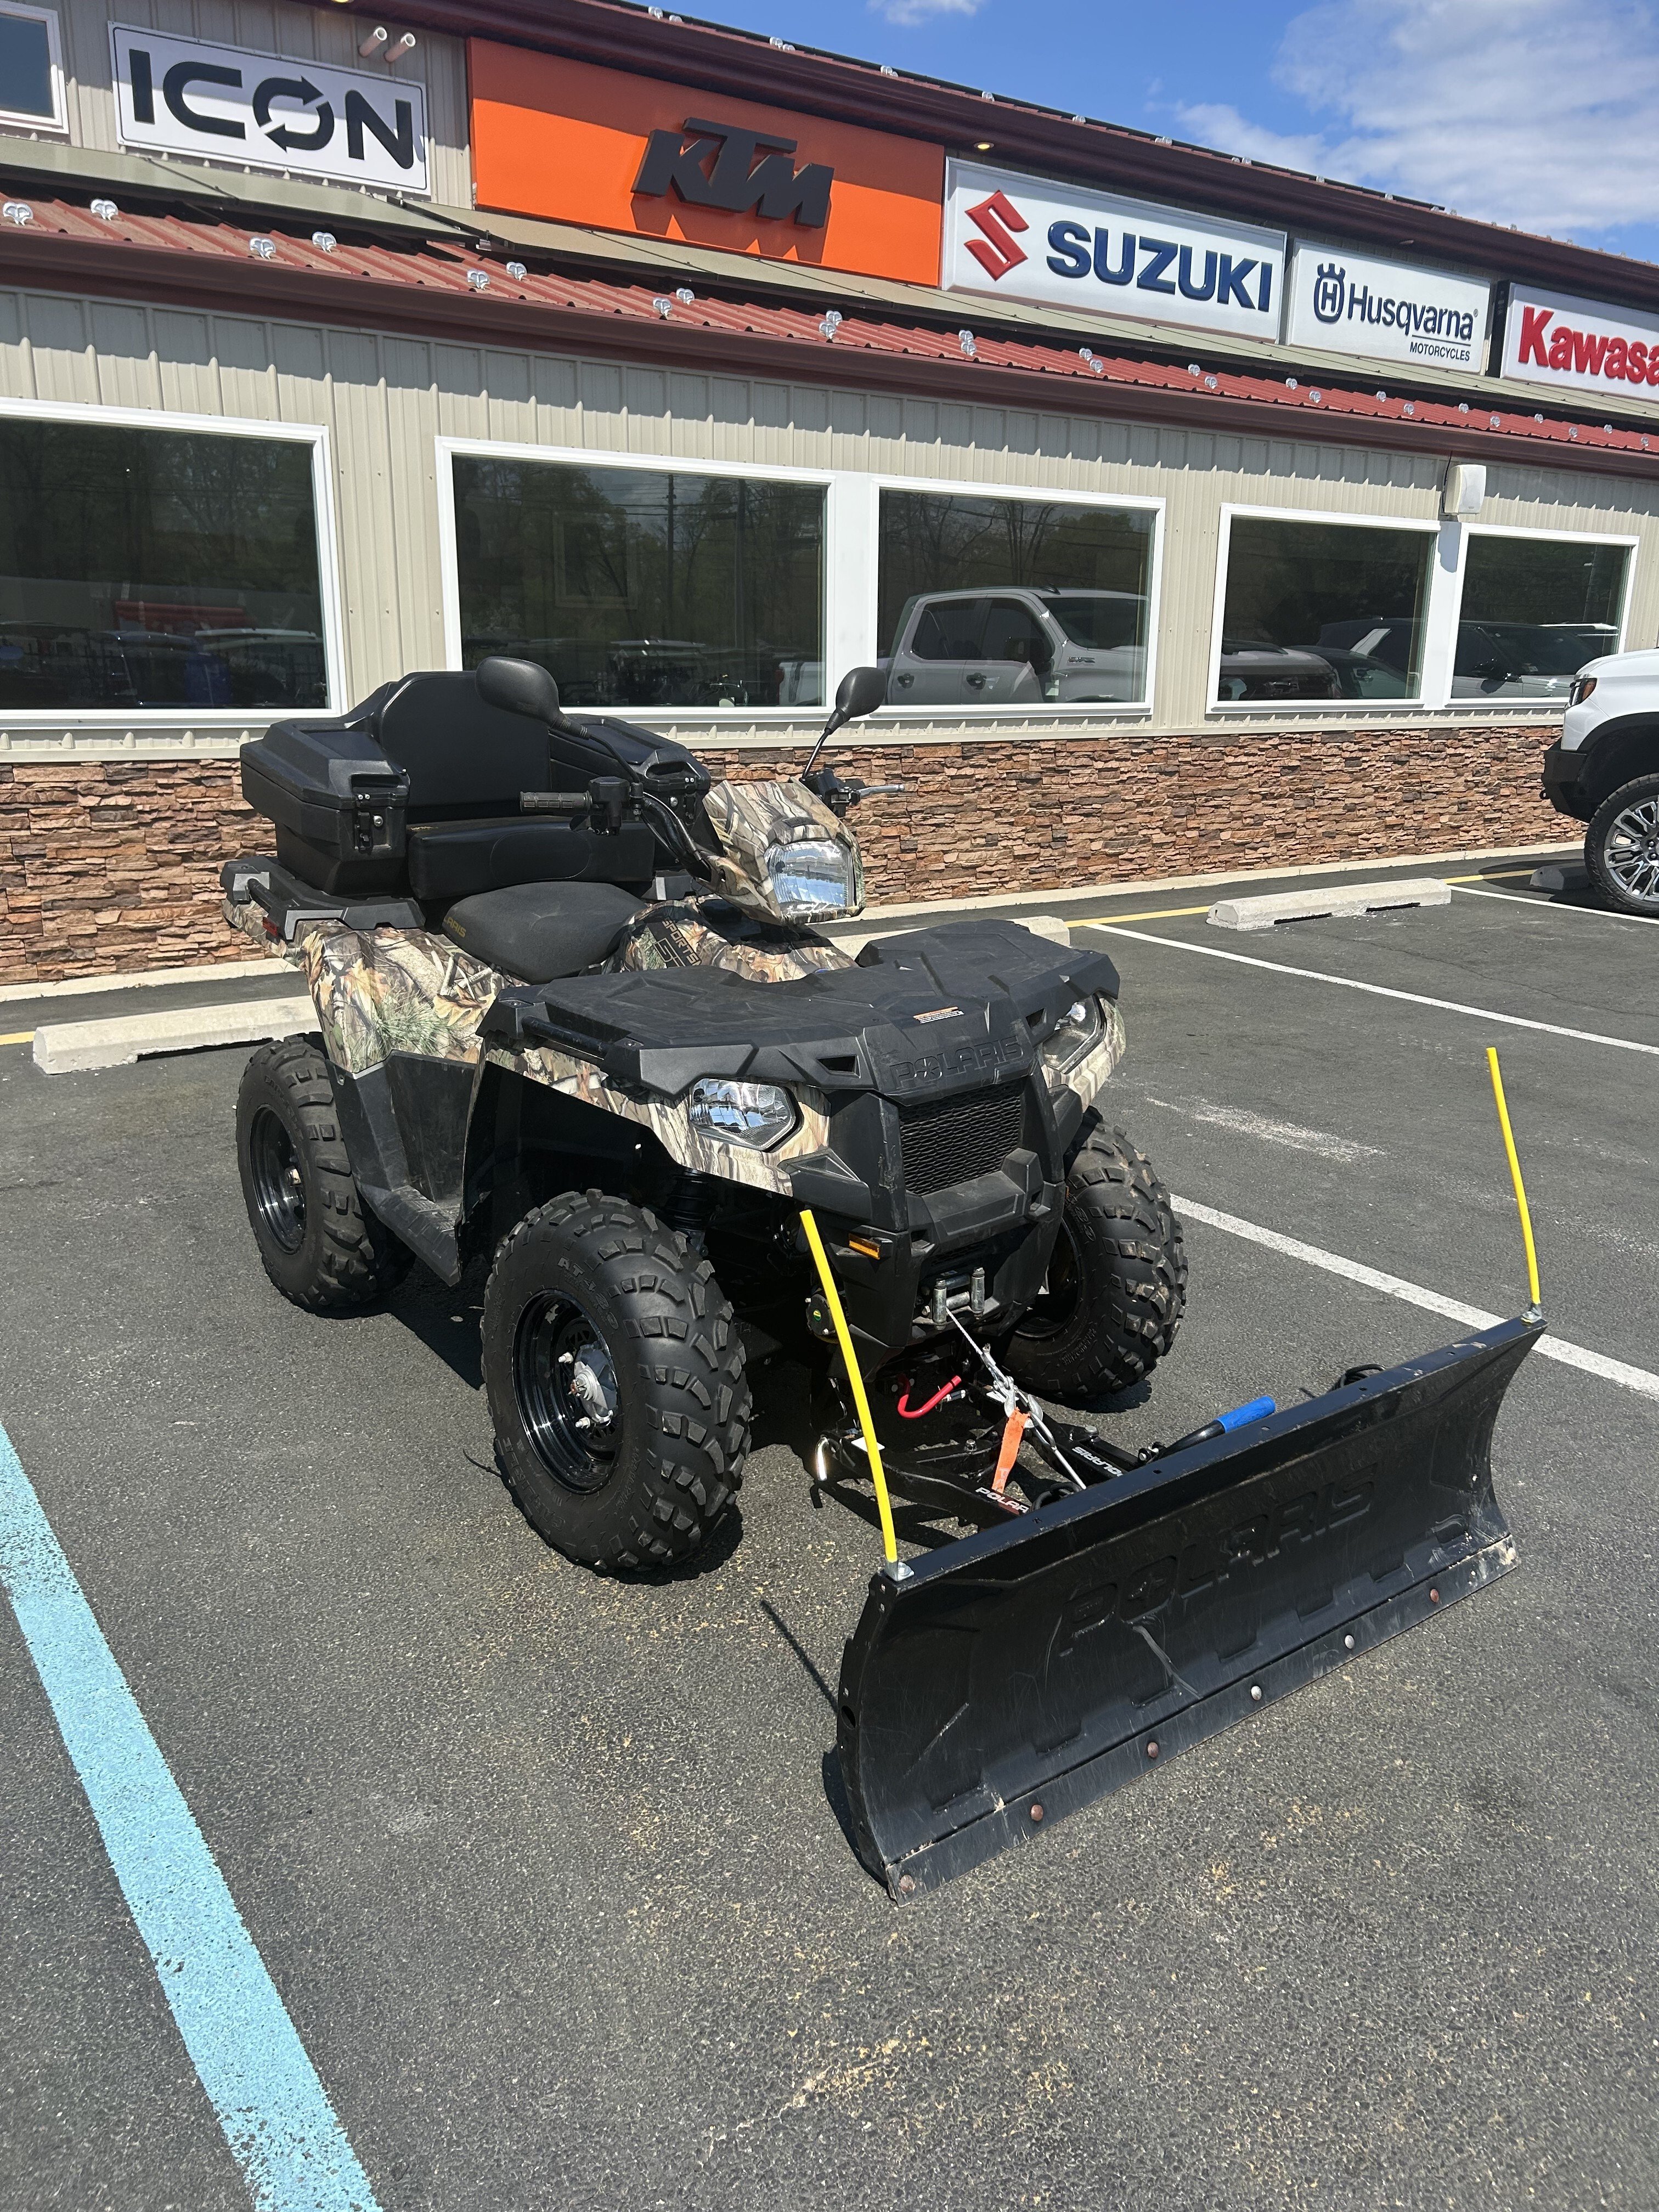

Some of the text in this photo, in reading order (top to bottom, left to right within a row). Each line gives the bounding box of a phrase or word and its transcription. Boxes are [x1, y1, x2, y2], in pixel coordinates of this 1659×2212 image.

[129, 49, 414, 170] ICON
[631, 117, 835, 229] KTM
[1046, 221, 1273, 312] SUZUKI
[1347, 283, 1473, 340] Husqvarna
[1409, 341, 1470, 362] MOTORCYCLES
[889, 1035, 1024, 1090] POLARIS
[1059, 1463, 1377, 1657] POLARIS
